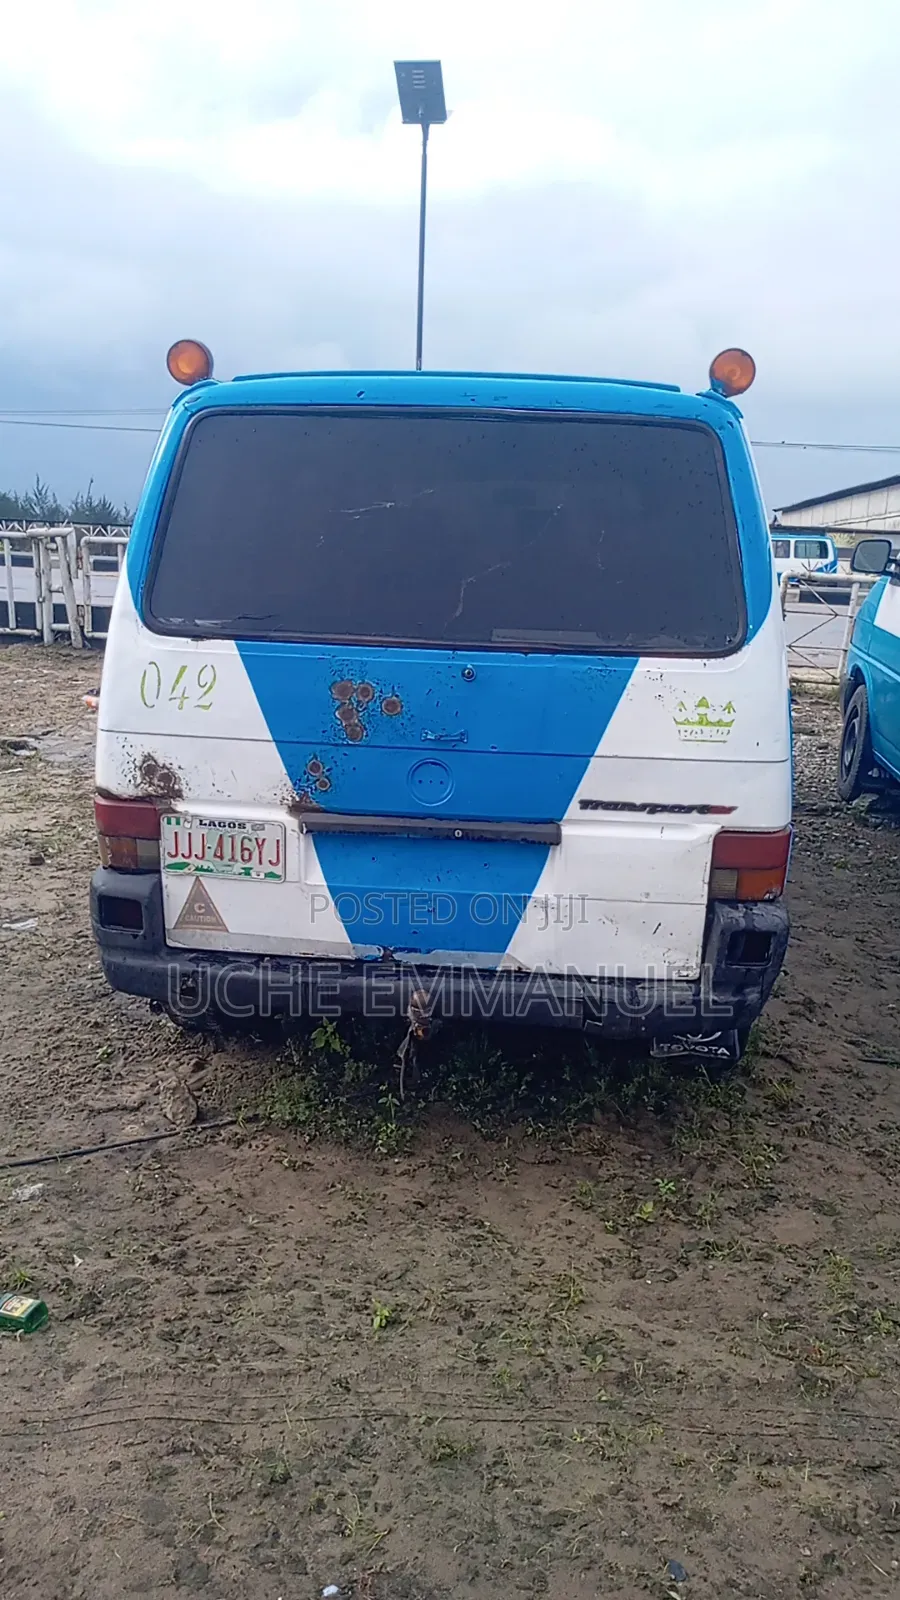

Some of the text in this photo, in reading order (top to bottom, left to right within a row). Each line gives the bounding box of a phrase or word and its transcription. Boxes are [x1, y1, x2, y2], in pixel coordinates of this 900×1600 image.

[141, 661, 217, 711] 042
[198, 819, 248, 830] LAGOS
[166, 831, 281, 867] JJJ-416YJ
[660, 1042, 731, 1056] TOYOTA
